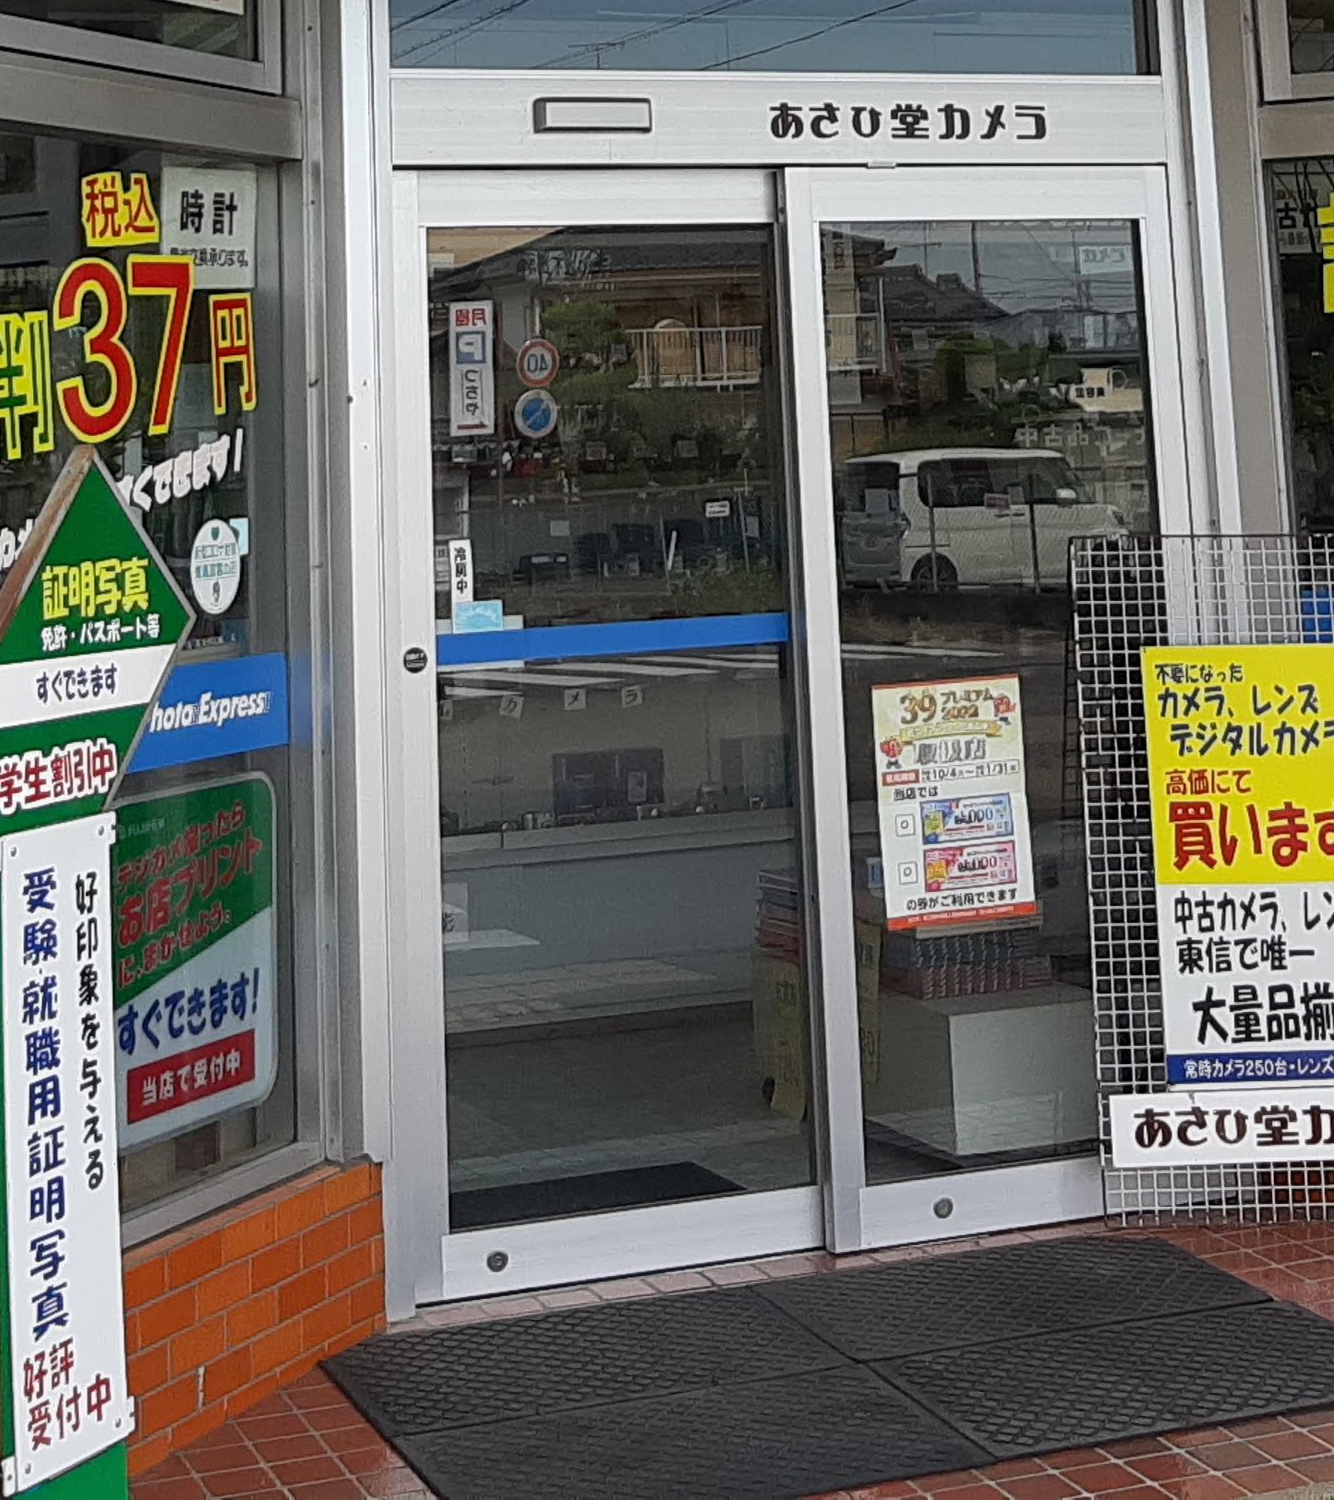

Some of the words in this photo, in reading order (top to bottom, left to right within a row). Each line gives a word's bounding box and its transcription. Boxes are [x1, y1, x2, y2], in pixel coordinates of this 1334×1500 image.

[769, 101, 1049, 140] あさひ堂カメラ
[83, 175, 157, 240] 税込
[180, 189, 238, 236] 時計
[41, 556, 150, 621] 証明写真
[40, 613, 161, 652] 免許・パスポート等
[35, 662, 118, 707] すぐできます
[1155, 662, 1244, 684] 不要になった
[149, 701, 197, 734] hoto
[197, 691, 269, 729] Express
[1165, 768, 1252, 796] 高価にて
[118, 825, 264, 949] お店プリント
[1177, 934, 1317, 974] 東信で唯一
[74, 870, 106, 1191] 好印象を与える
[117, 966, 261, 1057] すぐできます!
[141, 1047, 242, 1106] 当店で受付中
[22, 1336, 75, 1402] 好評
[27, 1373, 113, 1451] 受付中
